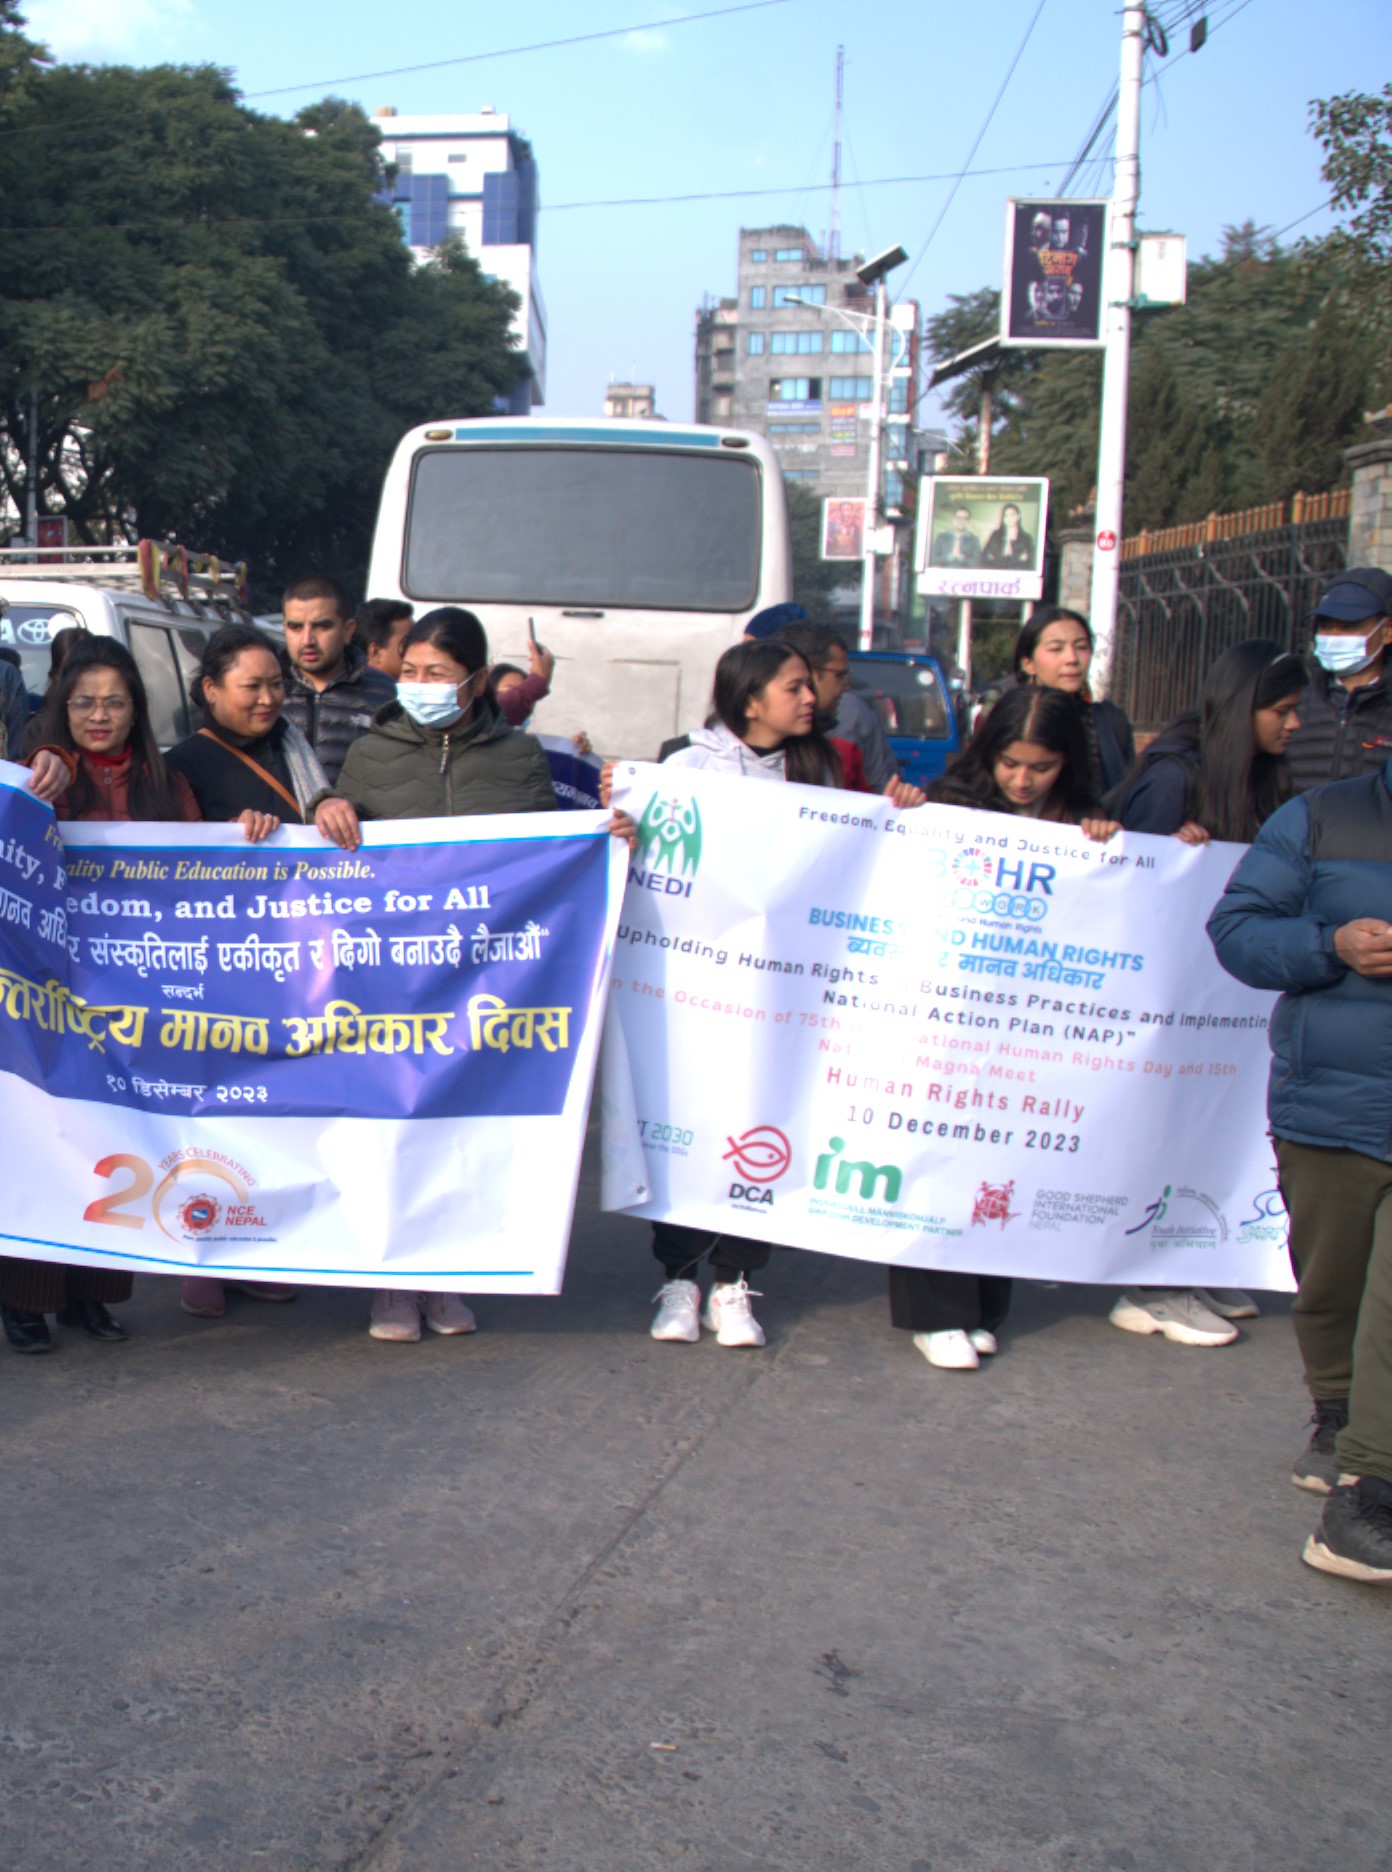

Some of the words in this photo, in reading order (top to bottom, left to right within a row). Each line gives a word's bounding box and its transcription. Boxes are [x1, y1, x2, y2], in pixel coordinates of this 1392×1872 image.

[974, 832, 1008, 848] and
[1017, 839, 1091, 861] Justice
[1100, 850, 1129, 866] for
[1135, 855, 1156, 869] All
[110, 861, 169, 880] Public
[175, 861, 268, 881] Education
[274, 868, 288, 880] is
[294, 861, 376, 880] Possible.
[627, 866, 692, 898] NEDI
[175, 895, 236, 919] and
[247, 892, 372, 921] Justice
[384, 890, 433, 912] for
[444, 886, 491, 910] All
[88, 932, 209, 978] संस्कृतिलाई
[217, 934, 301, 983] एकीकृत
[308, 940, 325, 970] र
[332, 928, 382, 970] दिगो
[971, 932, 1057, 960] HUMAN
[1062, 943, 1144, 972] RIGHTS
[958, 953, 1019, 977] मानव
[1022, 958, 1107, 990] अधिकार
[738, 953, 806, 975] Human
[811, 962, 879, 985] Rights
[920, 980, 1018, 1007] Business
[1027, 993, 1131, 1021] Practices
[1140, 1011, 1175, 1026] and
[160, 1008, 269, 1055] मानव
[283, 1000, 455, 1057] अधिकार
[468, 994, 572, 1053] दिवस
[633, 979, 666, 998] the
[674, 990, 767, 1021] Occasion
[775, 1010, 793, 1024] of
[998, 1039, 1064, 1063] Human
[1072, 1051, 1136, 1075] Rights
[1143, 1059, 1173, 1079] Day
[1178, 1063, 1203, 1076] and
[1209, 1061, 1237, 1077] 15th
[928, 1007, 1000, 1030] Action
[1008, 1016, 1055, 1037] Plan
[988, 1063, 1036, 1083] Meet
[216, 1084, 268, 1103] २०२३
[927, 1082, 1009, 1111] Rights
[1021, 1095, 1085, 1124] Rally
[651, 1122, 694, 1146] 2030
[847, 1105, 874, 1125] 10
[888, 1110, 1014, 1145] December
[1025, 1129, 1081, 1154] 2023
[813, 1136, 903, 1204] im
[228, 1204, 256, 1216] NCE
[728, 1183, 775, 1206] DCA
[1034, 1200, 1120, 1216] INTERNATIONAL
[1035, 1190, 1072, 1202] GOOD
[1074, 1193, 1129, 1206] SHEPHERD
[225, 1216, 267, 1226] NEPAL
[1031, 1209, 1106, 1225] FOUNDATION
